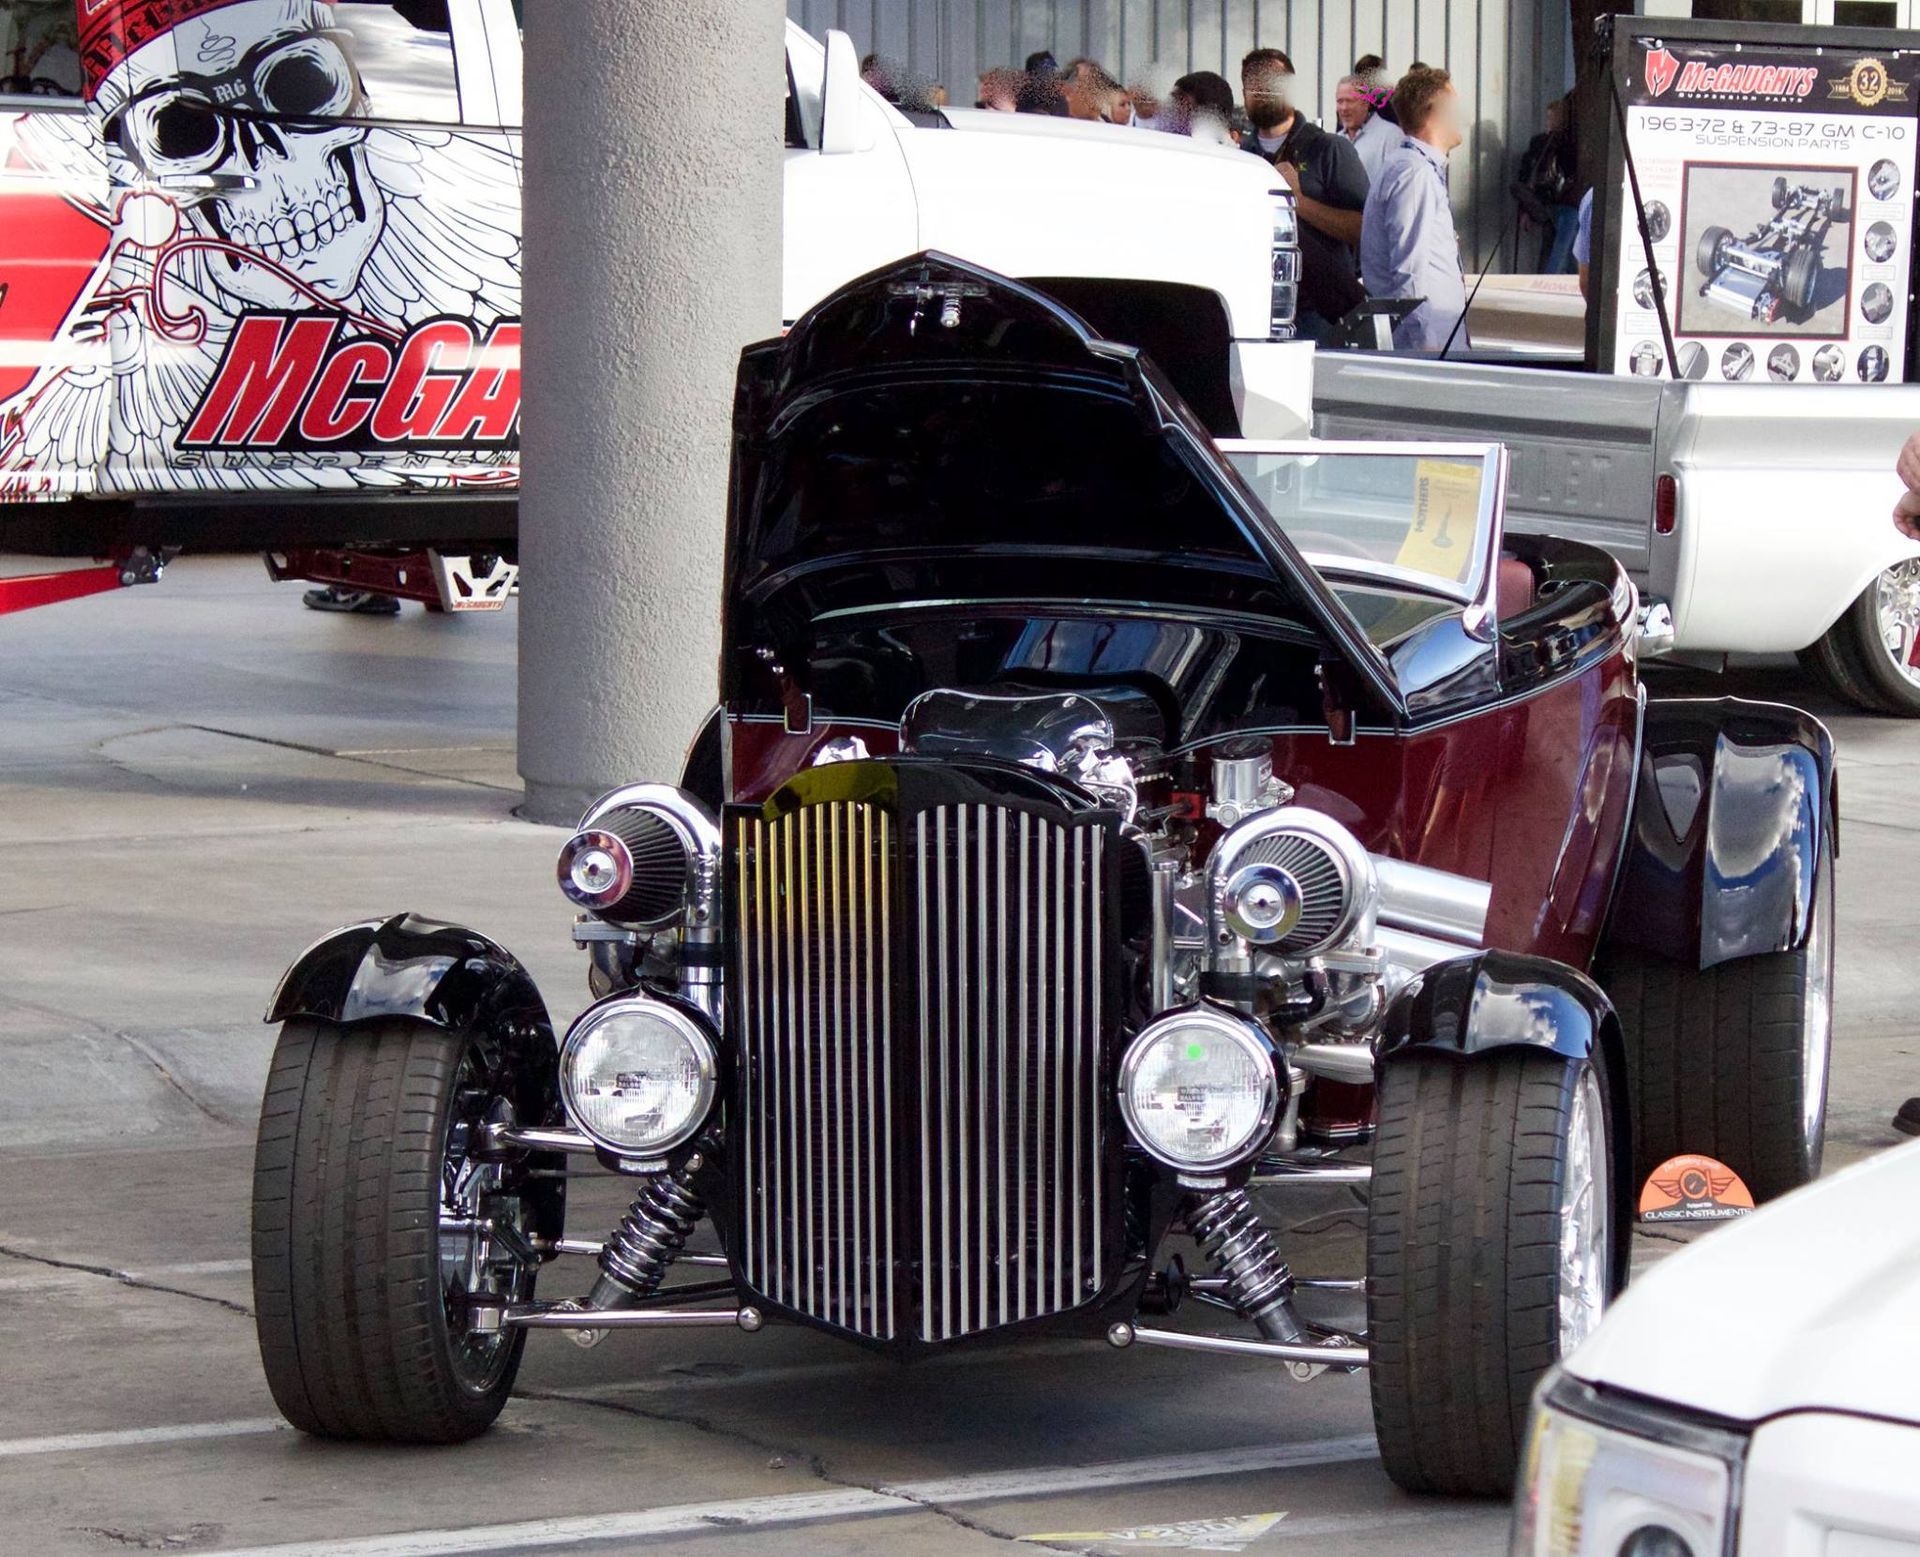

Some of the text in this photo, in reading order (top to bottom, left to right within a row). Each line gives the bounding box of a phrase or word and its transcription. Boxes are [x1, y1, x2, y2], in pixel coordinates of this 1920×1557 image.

[1675, 61, 1818, 97] McGAUGHYS
[1860, 71, 1879, 91] 32
[1678, 92, 1757, 101] SUSPENSION
[1640, 116, 1905, 140] 1963-72 & 73-87 GM C-10
[1695, 134, 1850, 151] SUSPENSION PARTS
[181, 317, 519, 445] McGA
[172, 452, 507, 469] SUSPENS
[1414, 477, 1430, 533] MOTHERS
[1644, 1208, 1686, 1219] CLASSIC
